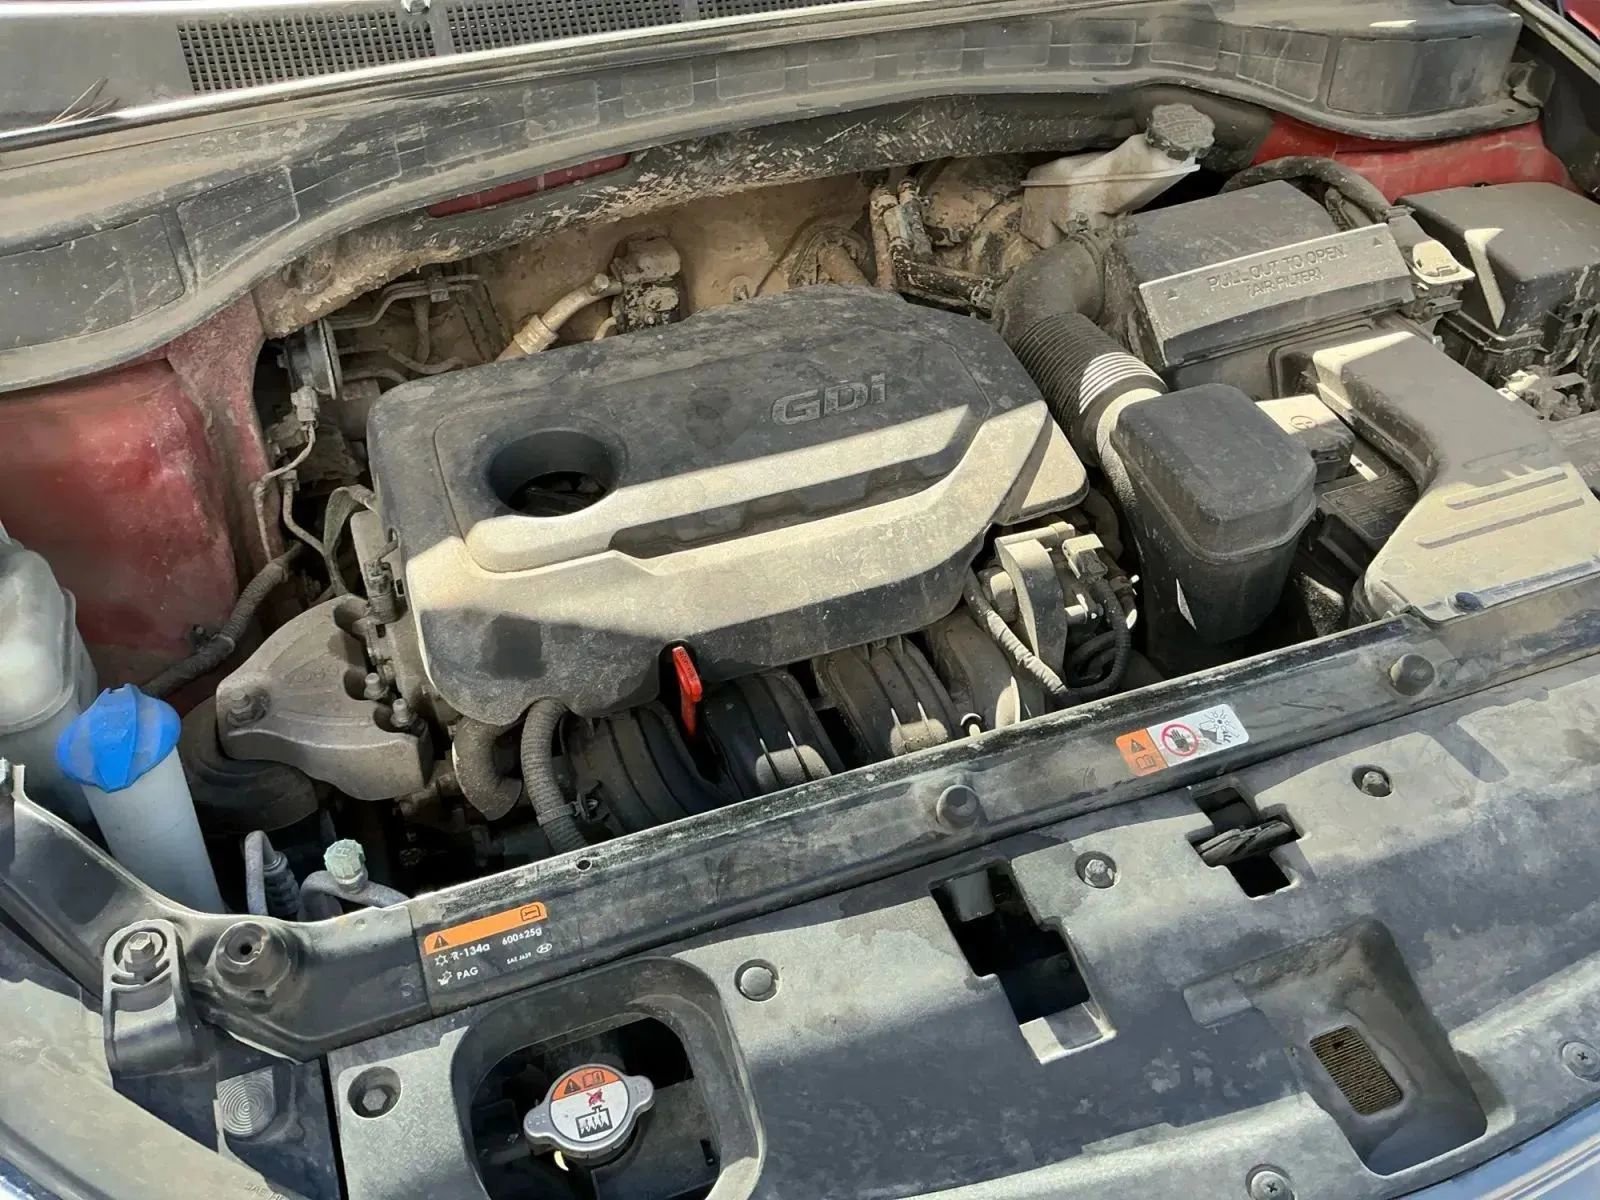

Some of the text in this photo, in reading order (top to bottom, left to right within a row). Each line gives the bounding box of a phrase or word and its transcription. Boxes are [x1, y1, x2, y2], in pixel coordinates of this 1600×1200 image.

[1207, 244, 1347, 291] PULL OUT TO OPEN
[771, 373, 886, 426] GDi
[451, 943, 490, 960] R-134a
[456, 967, 478, 980] PAG
